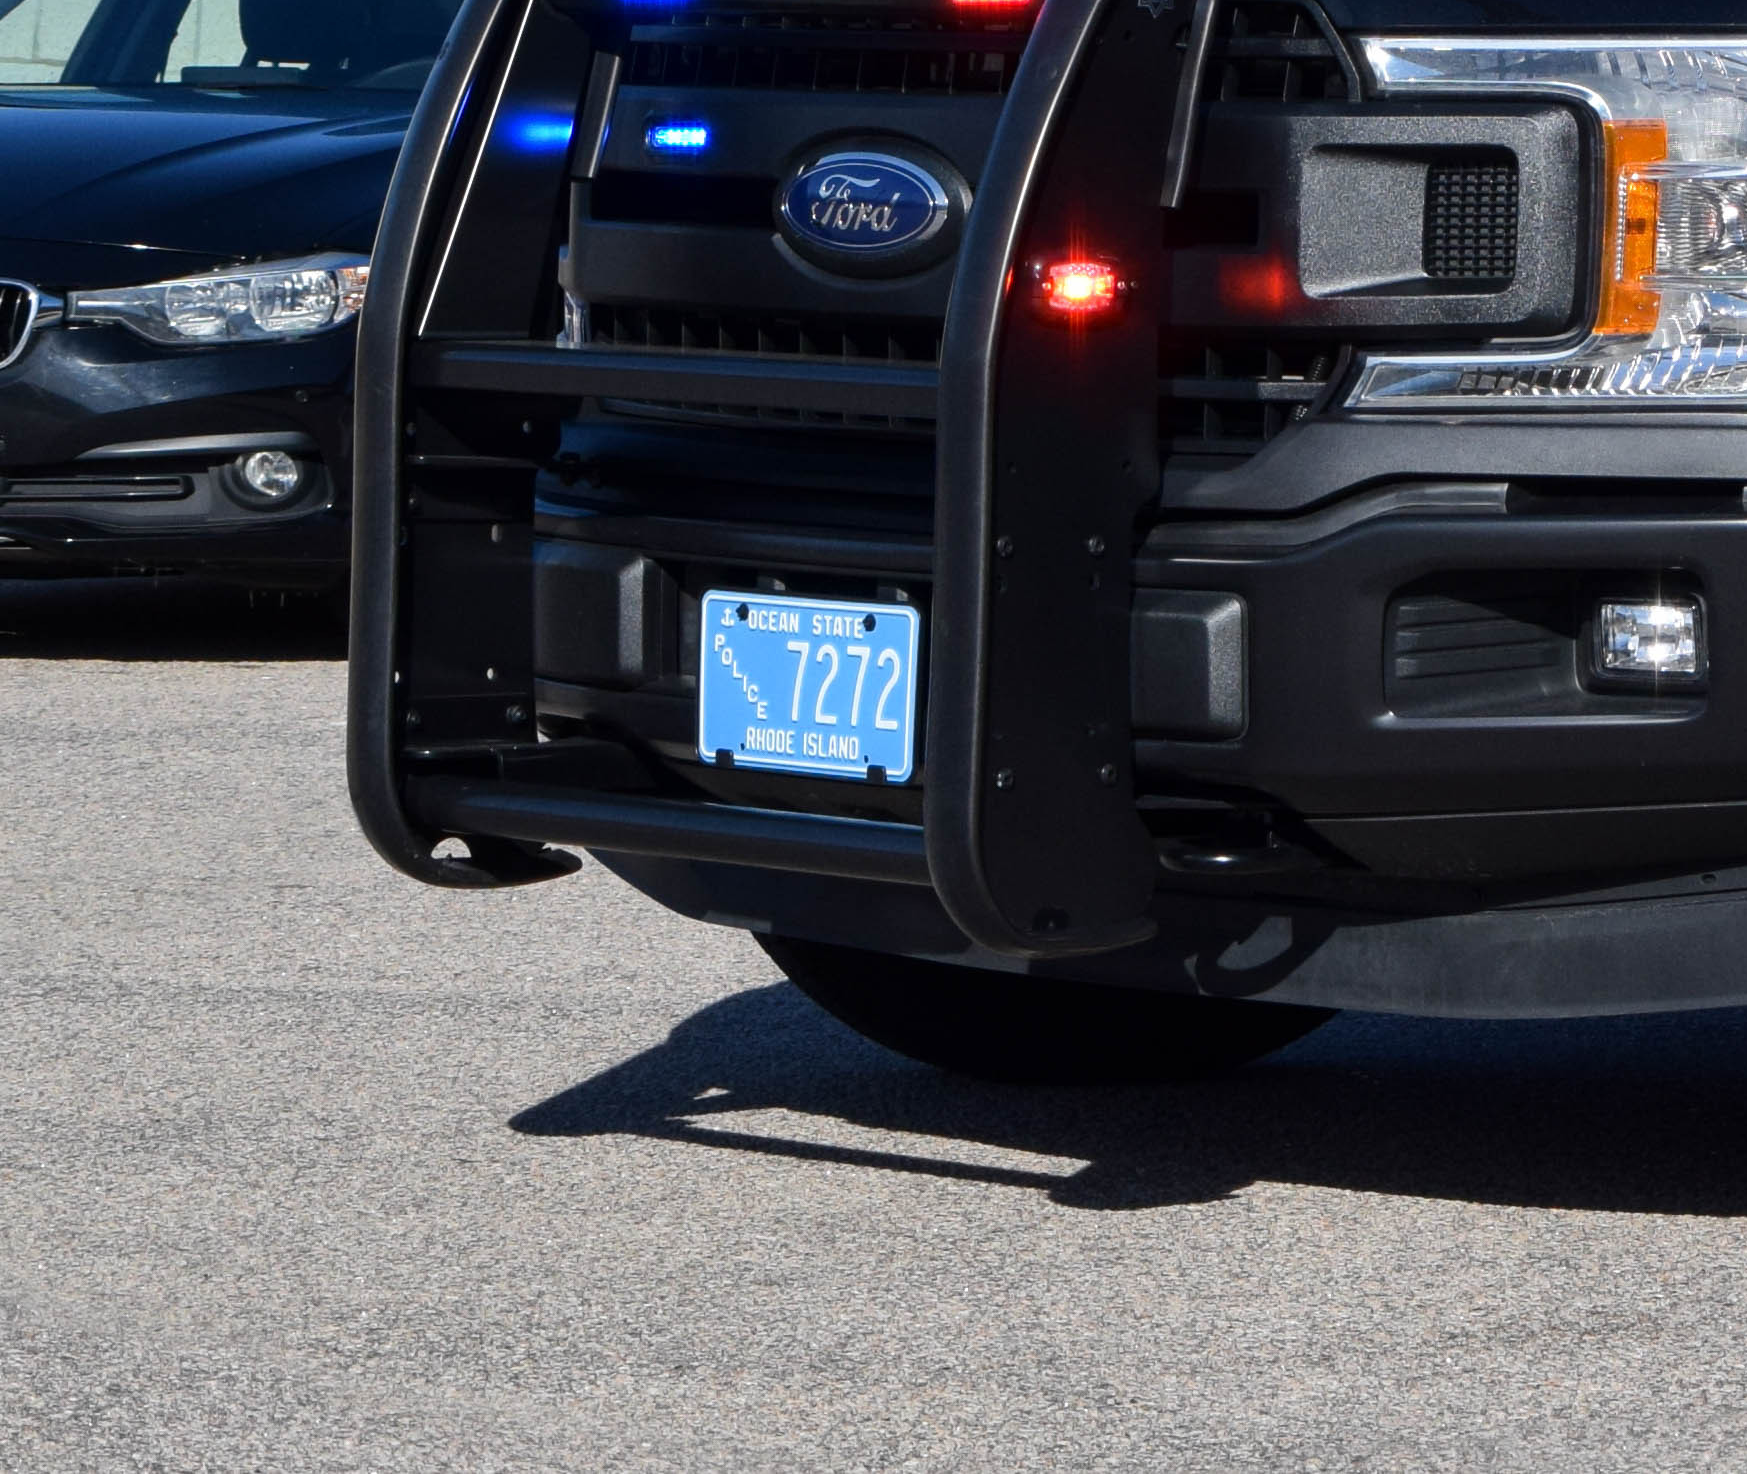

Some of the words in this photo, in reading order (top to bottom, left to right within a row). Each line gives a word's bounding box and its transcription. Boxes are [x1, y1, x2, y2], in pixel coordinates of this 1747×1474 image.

[809, 174, 899, 231] Ford
[747, 609, 799, 633] OCEAN
[813, 614, 864, 639] STATE
[714, 633, 768, 720] POLICE
[786, 640, 901, 731] 7272
[745, 726, 796, 755] RHODE
[802, 732, 860, 761] ISLAND
